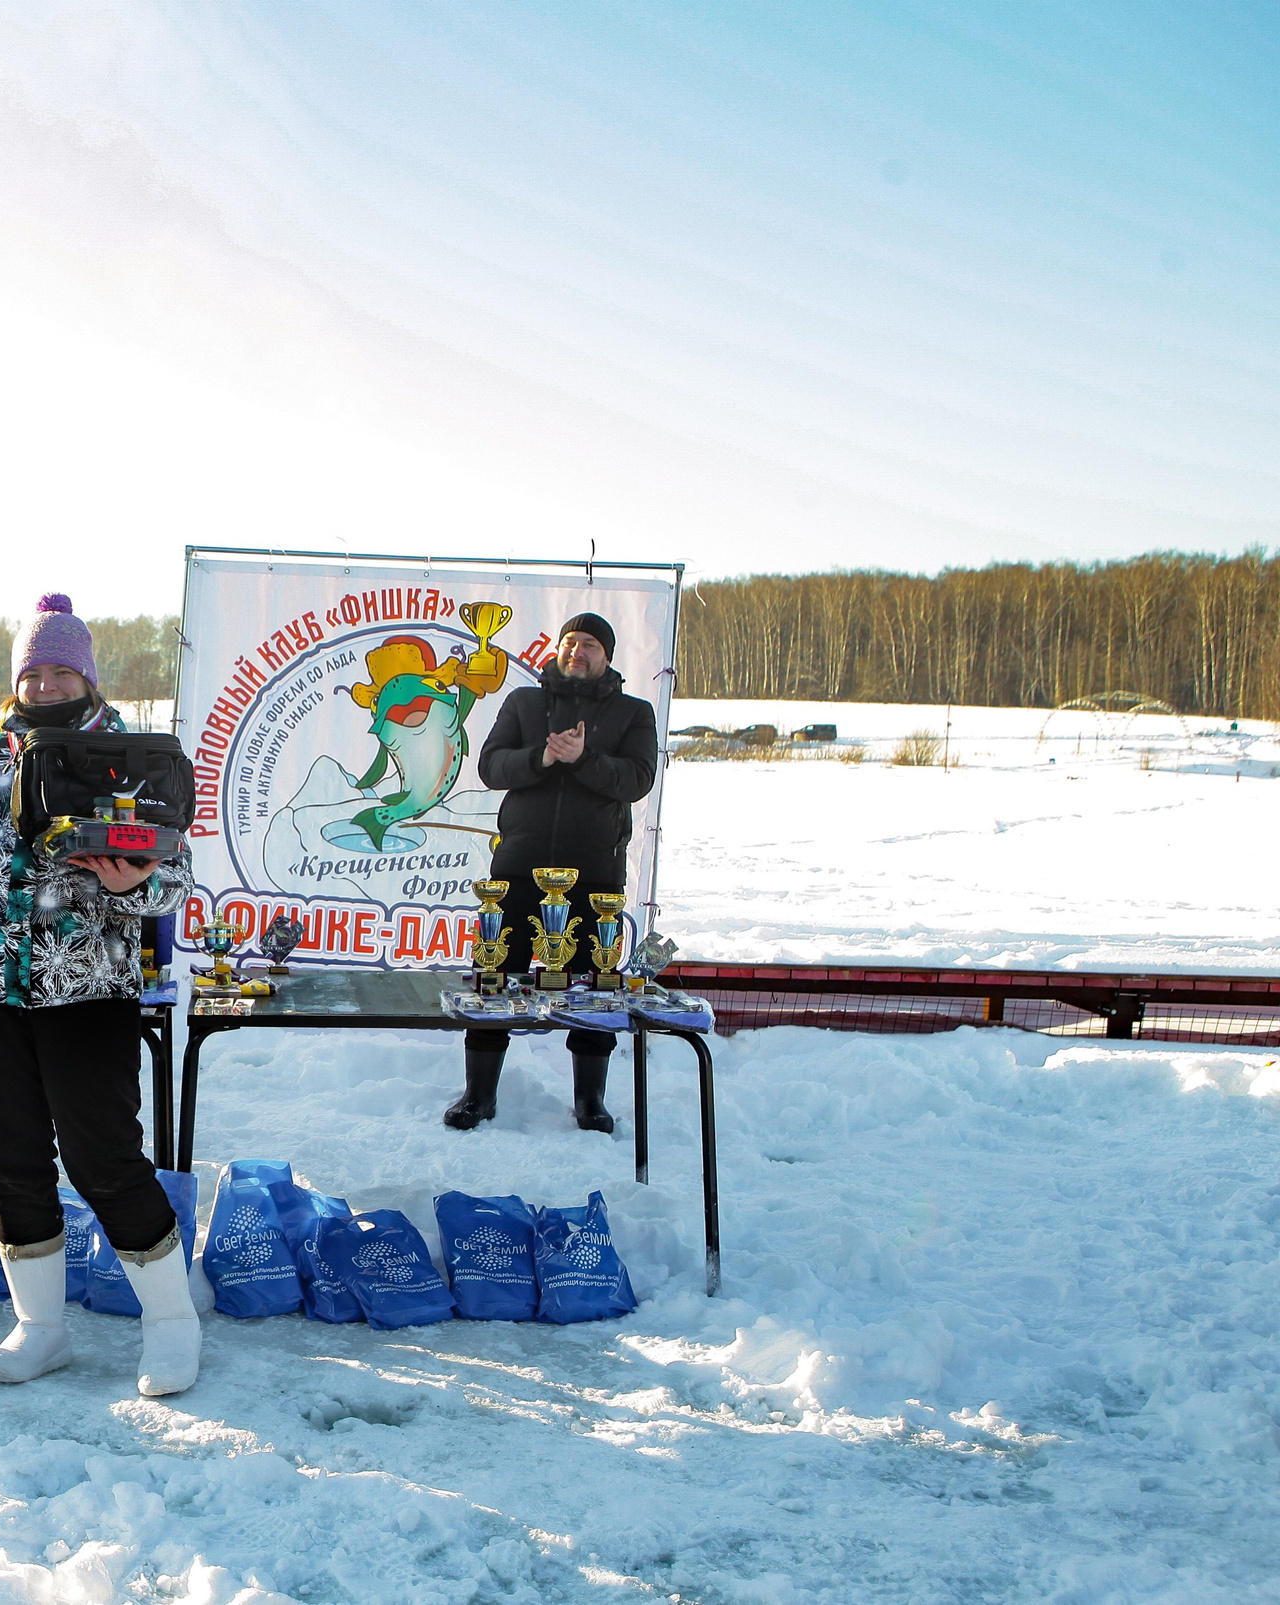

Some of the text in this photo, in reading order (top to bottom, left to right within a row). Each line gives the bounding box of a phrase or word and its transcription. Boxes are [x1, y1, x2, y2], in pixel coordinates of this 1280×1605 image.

[190, 587, 456, 838] РЫБОЛОВНЫЙ КЛУБ «ФИШКА»
[237, 650, 357, 836] ТУРНИР ПО ЛОВЛЕ ФОРЕЛИ СО ЛЬДА
[256, 690, 325, 818] НА АКТИВНУЮ СНАСТЬ
[137, 798, 167, 807] AIDA
[288, 852, 469, 881] «Крещенская
[184, 897, 206, 939] В
[215, 1234, 244, 1253] Свет
[454, 1238, 527, 1255] Свет Земли
[574, 1231, 613, 1247] Земли
[378, 1251, 420, 1269] Земли
[222, 1271, 297, 1288] ПОМОЩИ СПОРТСМЕНАМ
[454, 1268, 517, 1278] ЛАГОТВОРИТЕЛЬНЫЙ
[486, 1276, 533, 1285] СПОРТСМЕНАМ
[548, 1279, 579, 1289] ПОМОЩИ
